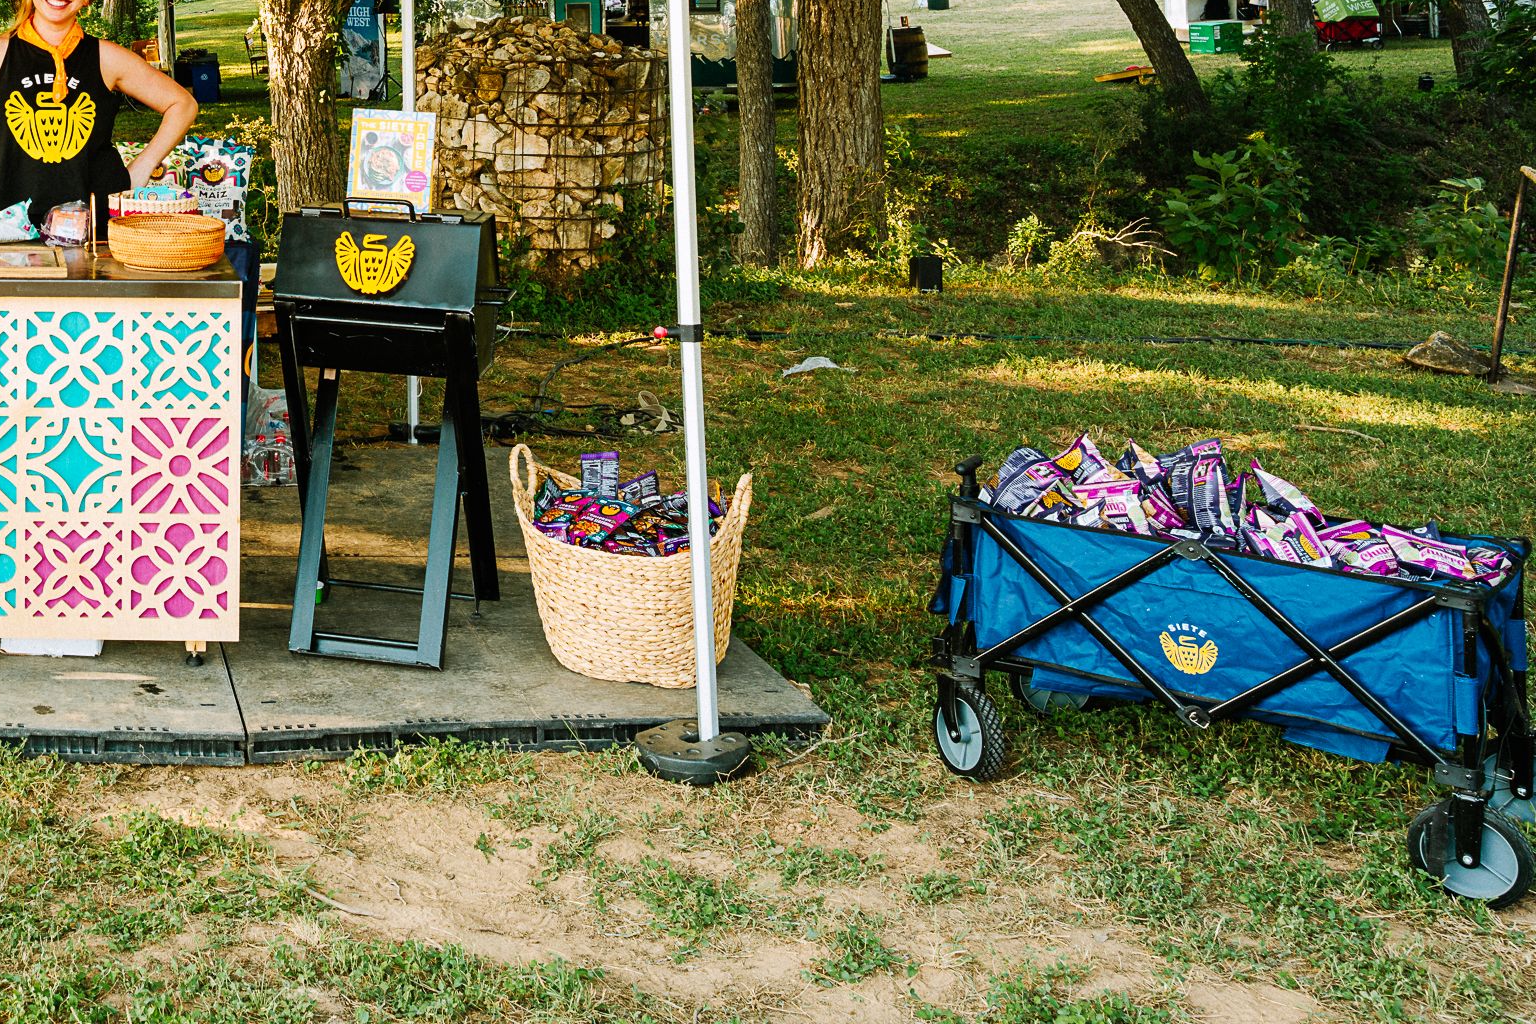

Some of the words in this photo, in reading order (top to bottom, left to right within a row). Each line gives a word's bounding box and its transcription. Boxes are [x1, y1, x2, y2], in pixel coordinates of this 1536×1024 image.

[21, 73, 80, 90] SIEE
[380, 122, 414, 132] SIETE
[1167, 622, 1208, 639] SIETE
